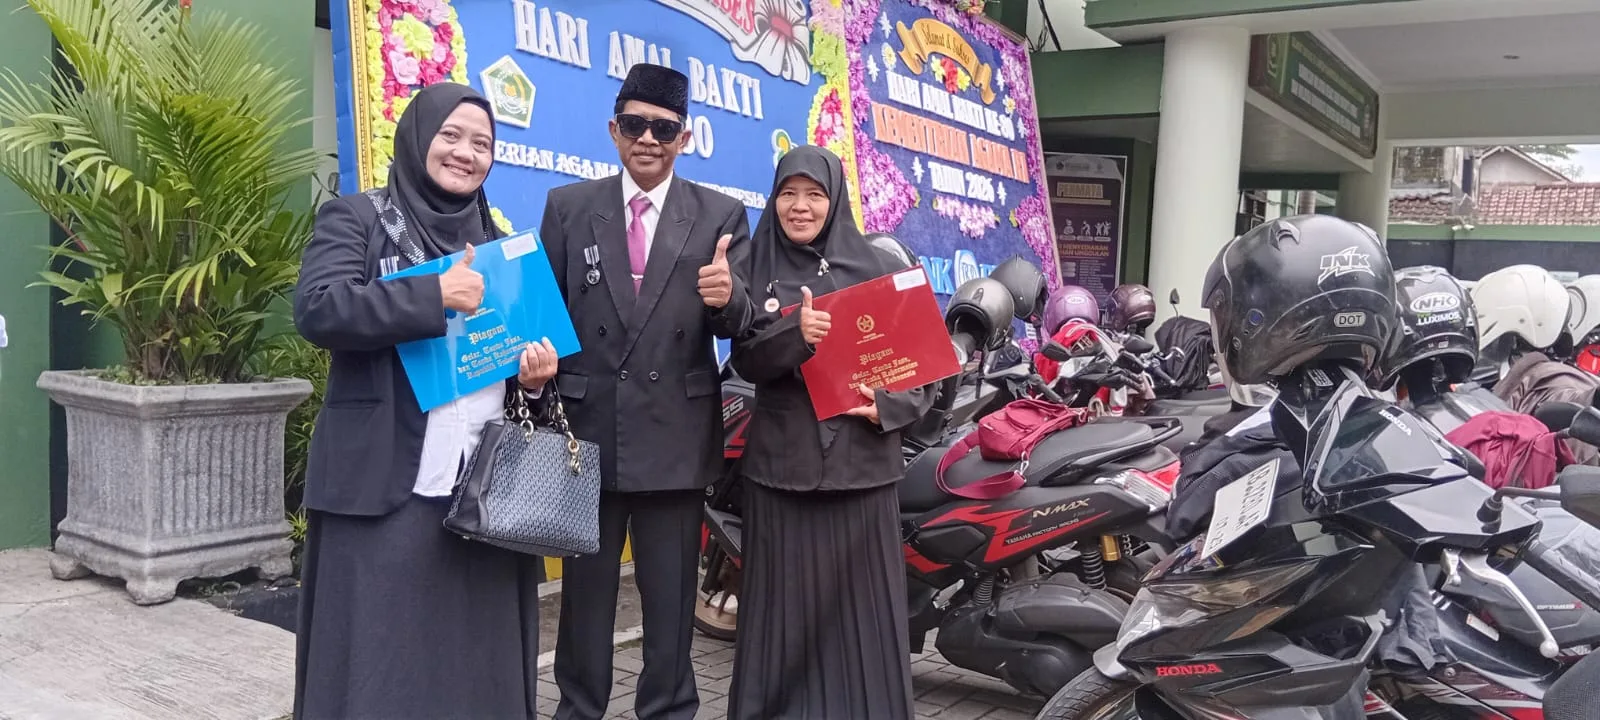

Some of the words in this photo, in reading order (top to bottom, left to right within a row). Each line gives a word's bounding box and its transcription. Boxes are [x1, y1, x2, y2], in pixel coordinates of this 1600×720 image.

[511, 0, 591, 69] HARI
[688, 56, 764, 120] BAKTI
[885, 69, 923, 109] HARI
[921, 82, 955, 120] AMAL
[951, 94, 987, 131] BAKTI
[554, 152, 620, 180] AGAMA
[969, 132, 1015, 179] AGAMA
[1010, 147, 1031, 185] RI
[927, 160, 967, 197] TAHUN
[964, 171, 996, 204] 2026
[1418, 294, 1458, 310] NHK
[1339, 314, 1363, 325] DOT
[469, 324, 506, 345] Piagam
[859, 347, 893, 364] Piagam
[1378, 408, 1413, 436] HONDA
[1032, 497, 1090, 518] NMAX
[1005, 532, 1032, 545] YAMAHA
[1032, 525, 1058, 537] FACTORY
[1155, 662, 1223, 677] HONDA
